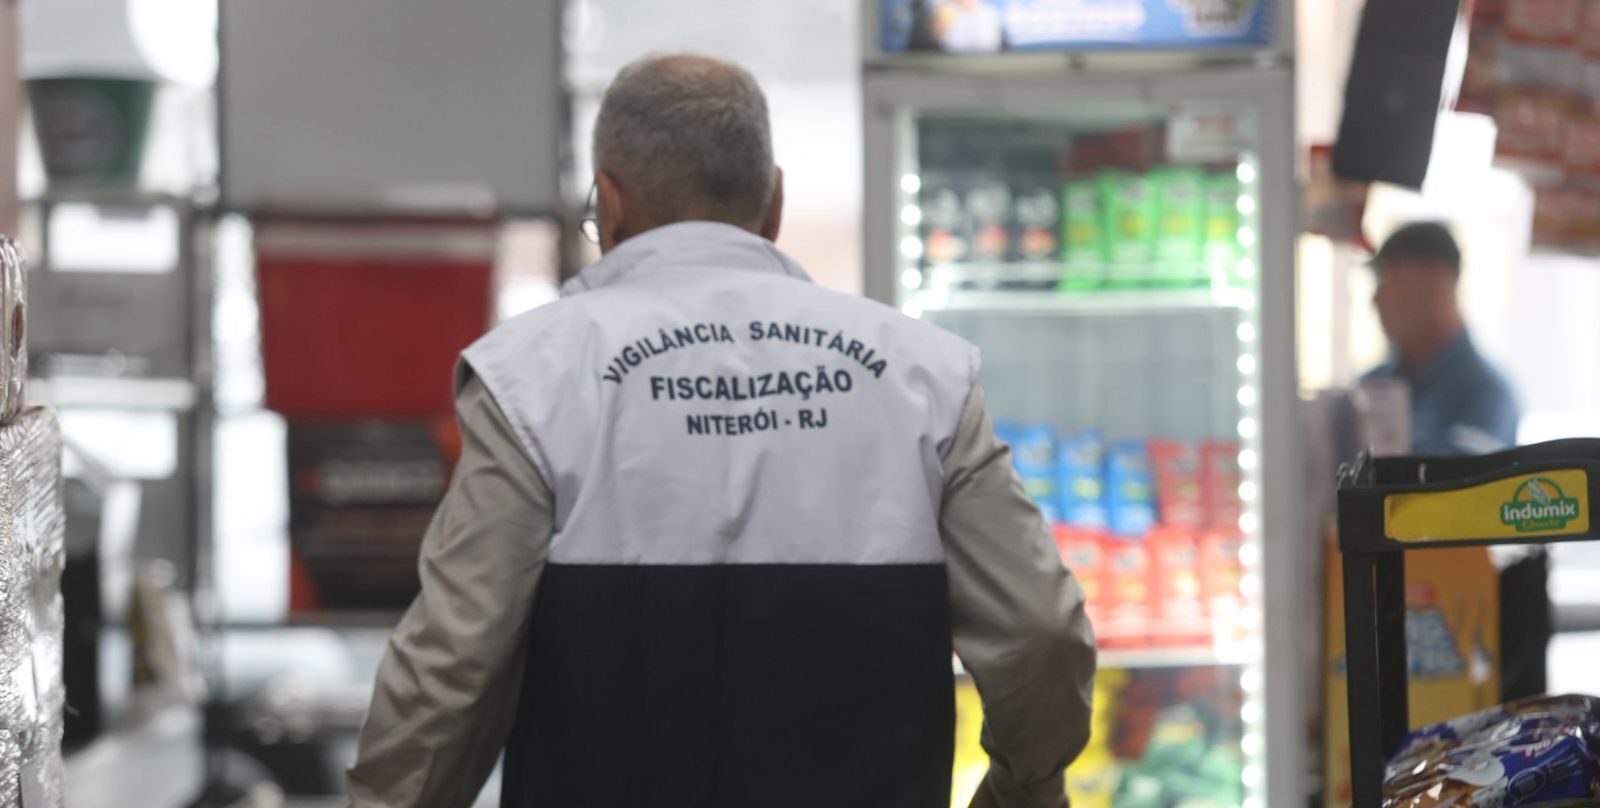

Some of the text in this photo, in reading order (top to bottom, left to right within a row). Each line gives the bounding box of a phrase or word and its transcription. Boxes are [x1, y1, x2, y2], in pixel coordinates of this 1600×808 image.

[749, 321, 888, 379] SANITÁRIA
[650, 365, 853, 400] FISCALIZAÇÃO
[687, 407, 778, 435] NITERÓI
[799, 409, 828, 429] RJ
[1504, 501, 1575, 521] indumix
